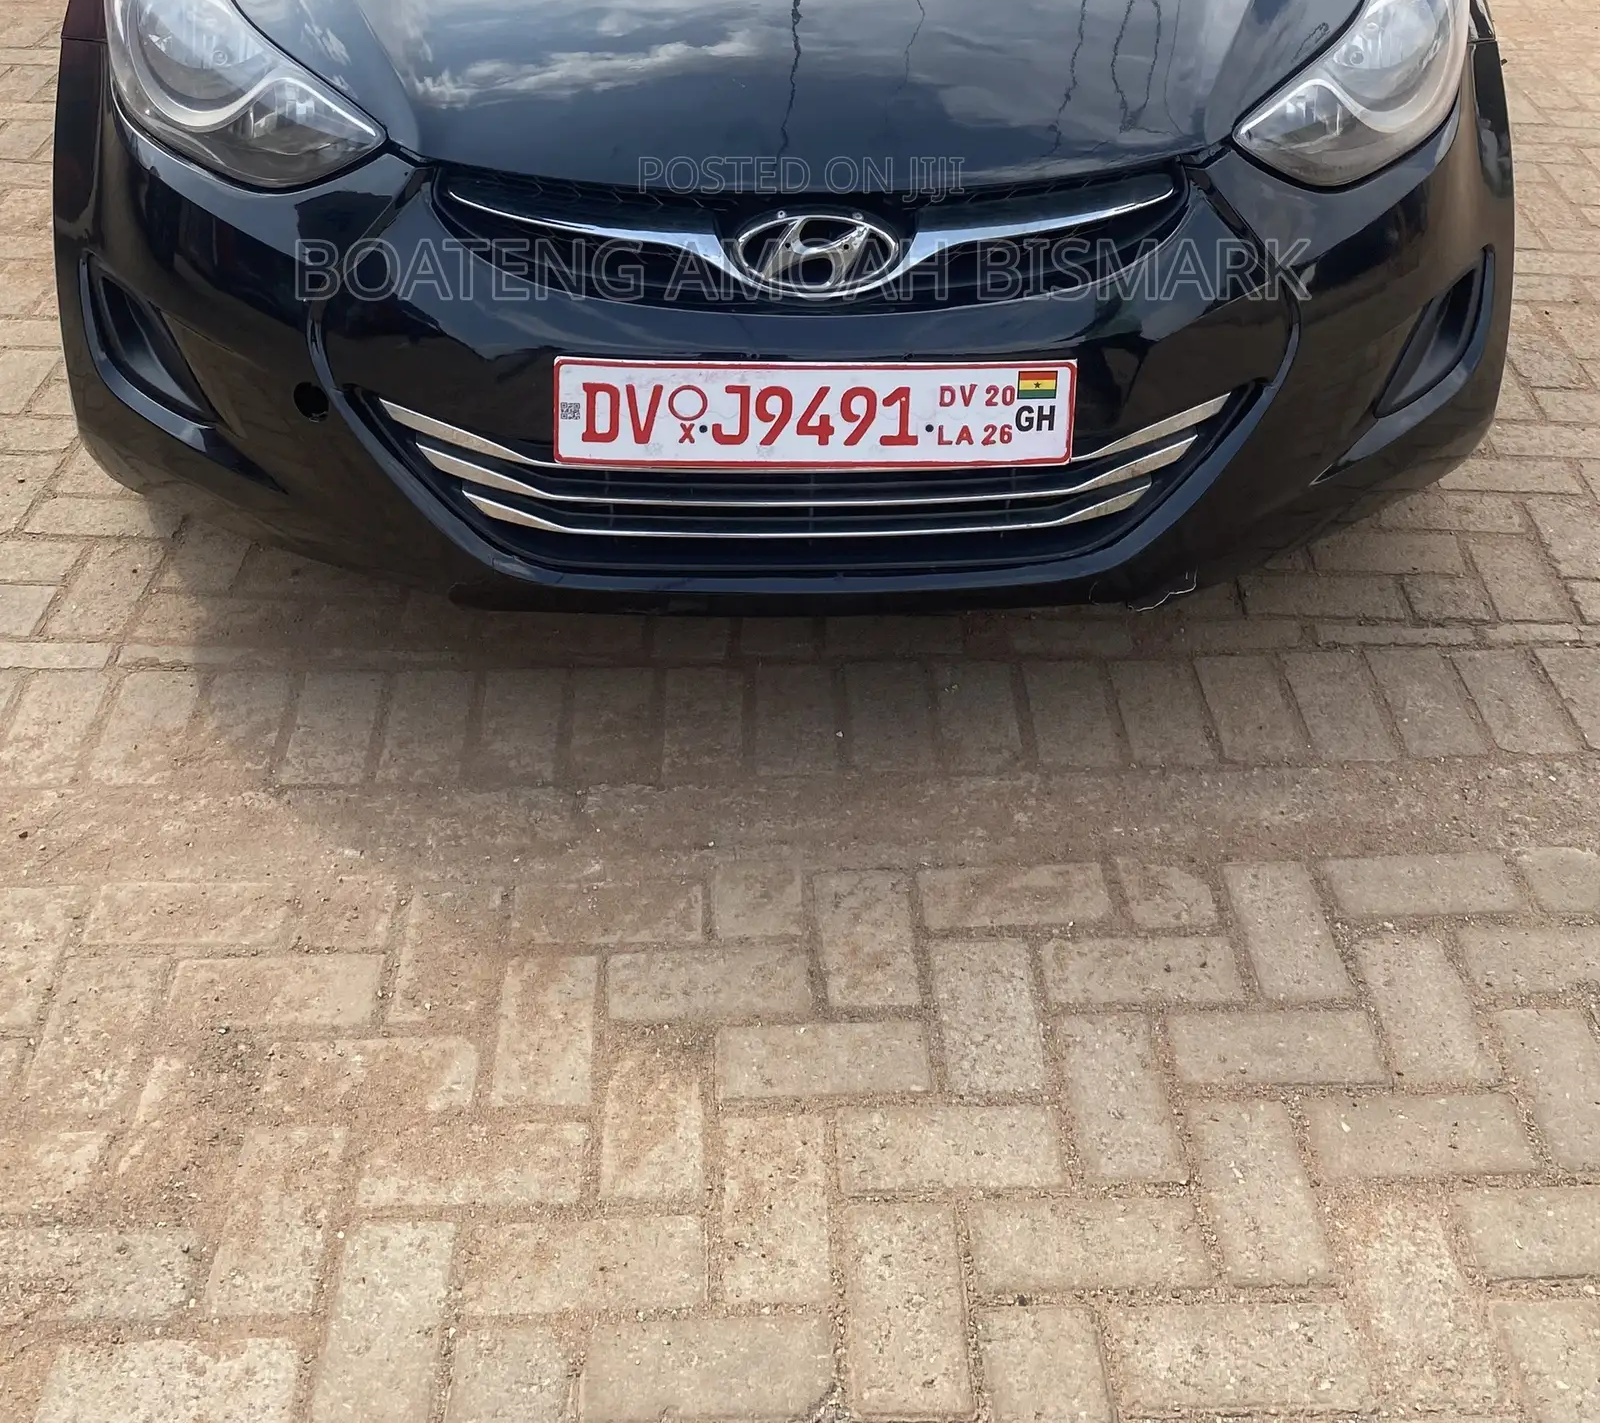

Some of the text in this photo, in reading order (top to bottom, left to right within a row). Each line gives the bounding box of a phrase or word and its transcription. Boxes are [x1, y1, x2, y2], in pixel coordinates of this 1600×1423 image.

[939, 384, 1016, 407] DV 20
[582, 382, 664, 444] DV
[711, 384, 920, 446] J9491
[1015, 405, 1056, 432] GH
[937, 424, 1013, 446] LA 26
